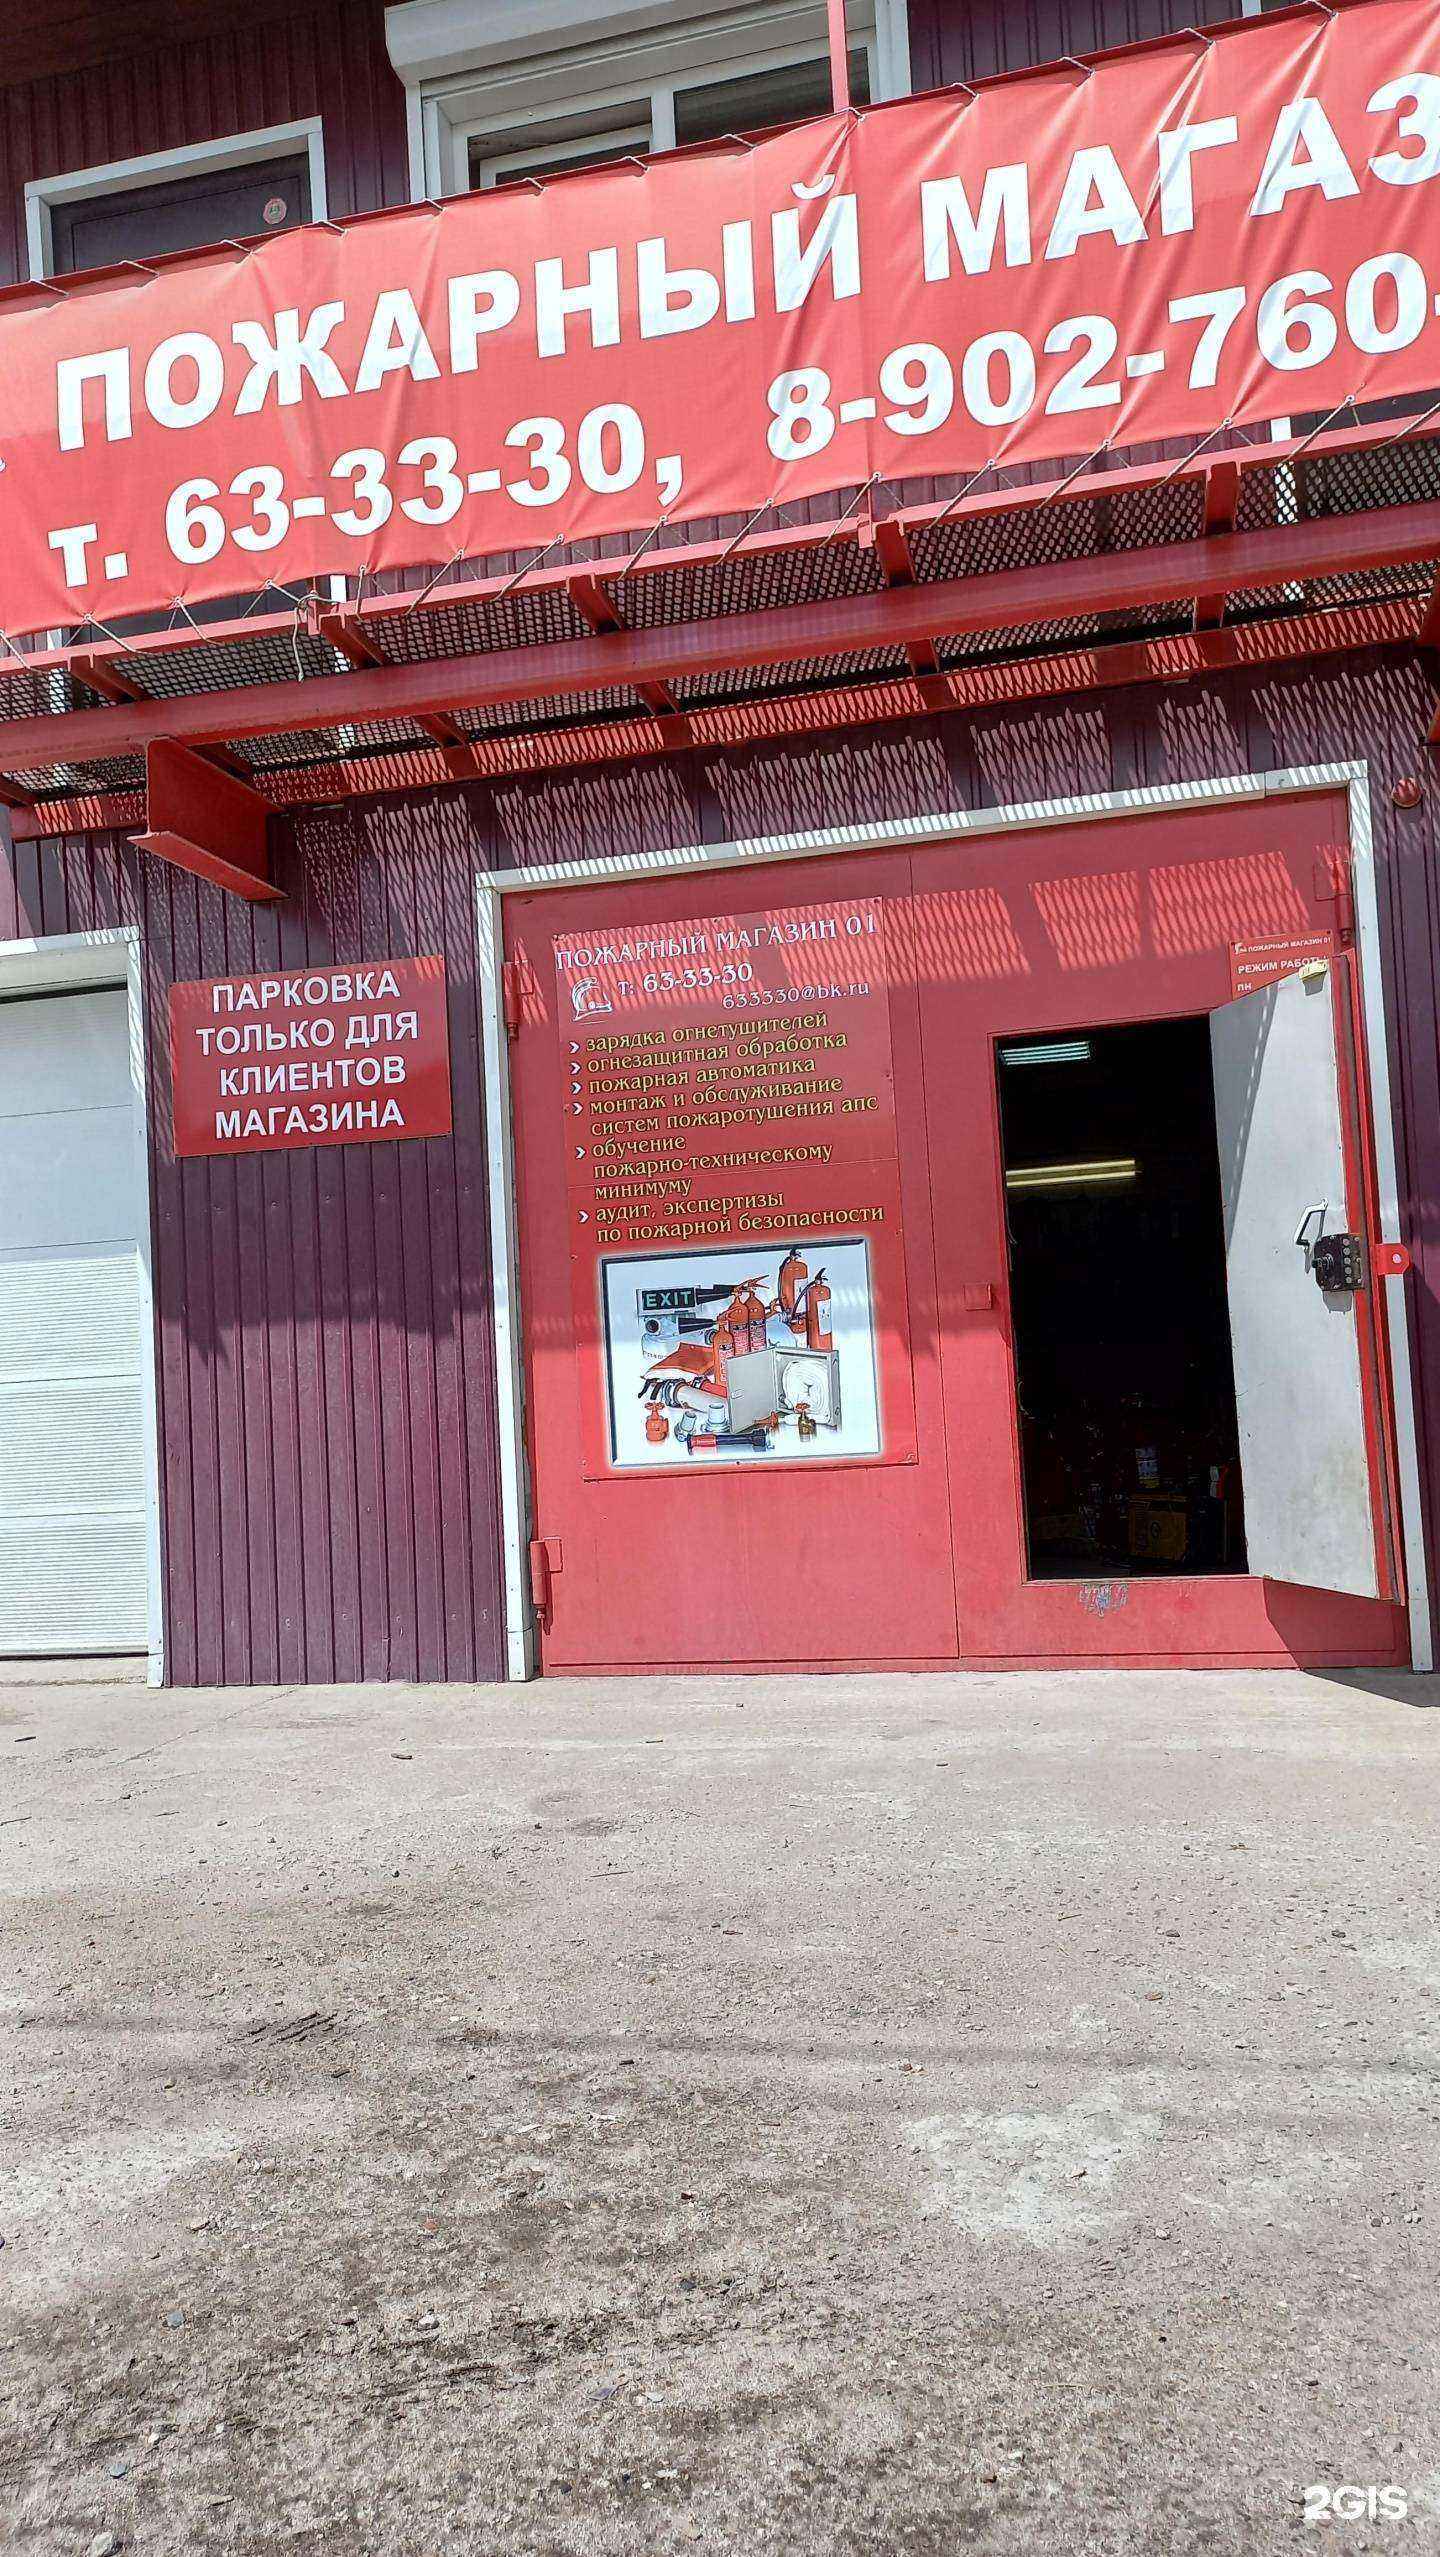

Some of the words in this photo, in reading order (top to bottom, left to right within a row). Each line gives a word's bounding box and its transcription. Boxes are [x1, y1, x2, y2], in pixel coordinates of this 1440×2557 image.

[56, 174, 861, 452] ПОЖАРНЫЙ
[919, 72, 1440, 283] МАГАЗ
[164, 402, 684, 566] 63-33-30,
[766, 251, 1440, 462] 8-902-760
[556, 930, 708, 971] ПОЖАРНЫЙ
[716, 918, 837, 951] МАГАЗИН
[846, 912, 878, 936] 01
[1248, 941, 1289, 953] ПОЖАРНЫЙ
[1290, 938, 1322, 949] МАГАЗИН
[643, 962, 753, 994] 63-33-30
[1238, 961, 1278, 975] РЕЖИМ
[212, 970, 401, 1013] ПАРКОВКА
[722, 981, 870, 1010] 633330@bk.ru
[196, 1018, 336, 1056] ТОЛЬКО
[344, 1011, 420, 1050] ДЛЯ
[586, 1030, 667, 1053] зарядка
[673, 1011, 829, 1042] огнетушителей
[588, 1045, 729, 1073] огнезащитная
[736, 1031, 849, 1058] обработка
[220, 1055, 407, 1097] КЛИЕНТОВ
[589, 1071, 689, 1096] пожарная
[696, 1059, 817, 1082] автоматика
[589, 1097, 667, 1116] монтаж
[673, 1094, 687, 1109] и
[692, 1077, 844, 1107] обслуживание
[215, 1099, 406, 1139] МАГАЗИНА
[591, 1114, 660, 1137] систем
[666, 1100, 835, 1132] пожаротушения
[841, 1096, 880, 1114] апс
[592, 1134, 687, 1159] обучение
[594, 1143, 834, 1180] пожарно-техническому
[594, 1178, 693, 1201] минимуму
[596, 1204, 657, 1225] аудит,
[663, 1191, 785, 1216] экспертизы
[596, 1227, 622, 1244] по
[628, 1217, 732, 1241] пожарной
[739, 1206, 885, 1231] безопасности
[645, 1291, 693, 1308] EXIT
